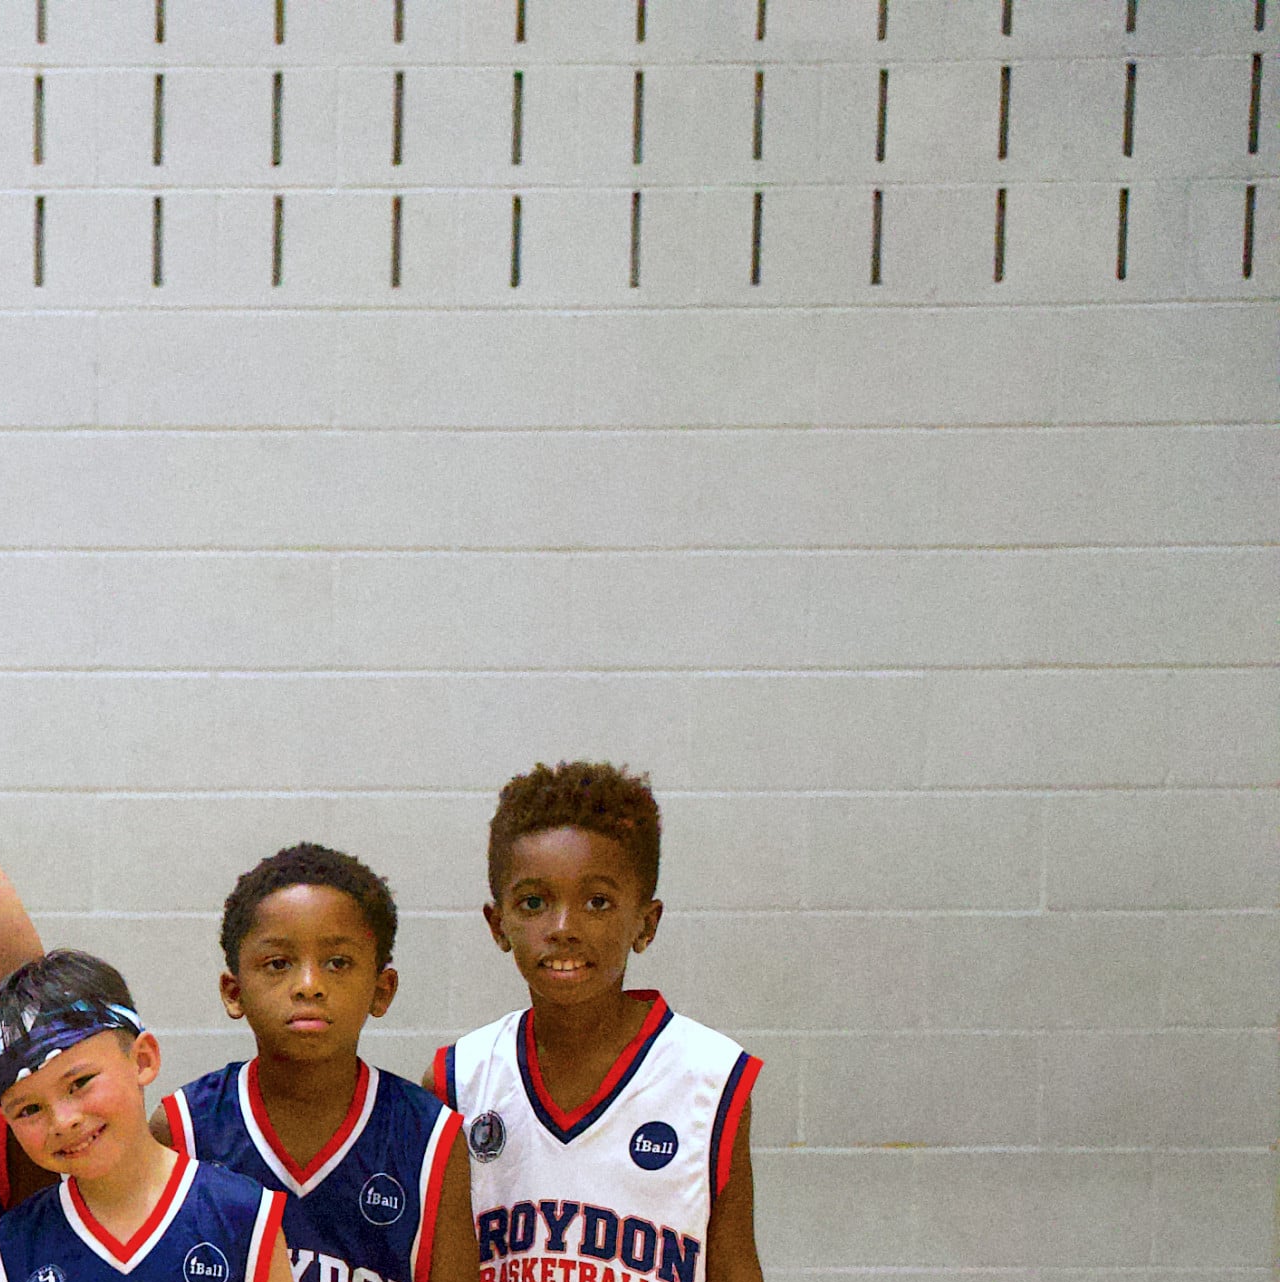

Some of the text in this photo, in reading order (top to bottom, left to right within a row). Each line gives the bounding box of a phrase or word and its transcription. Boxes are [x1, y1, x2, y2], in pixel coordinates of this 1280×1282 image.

[634, 1133, 674, 1155] iBall
[366, 1187, 399, 1209] iBall
[190, 1257, 224, 1278] iBall
